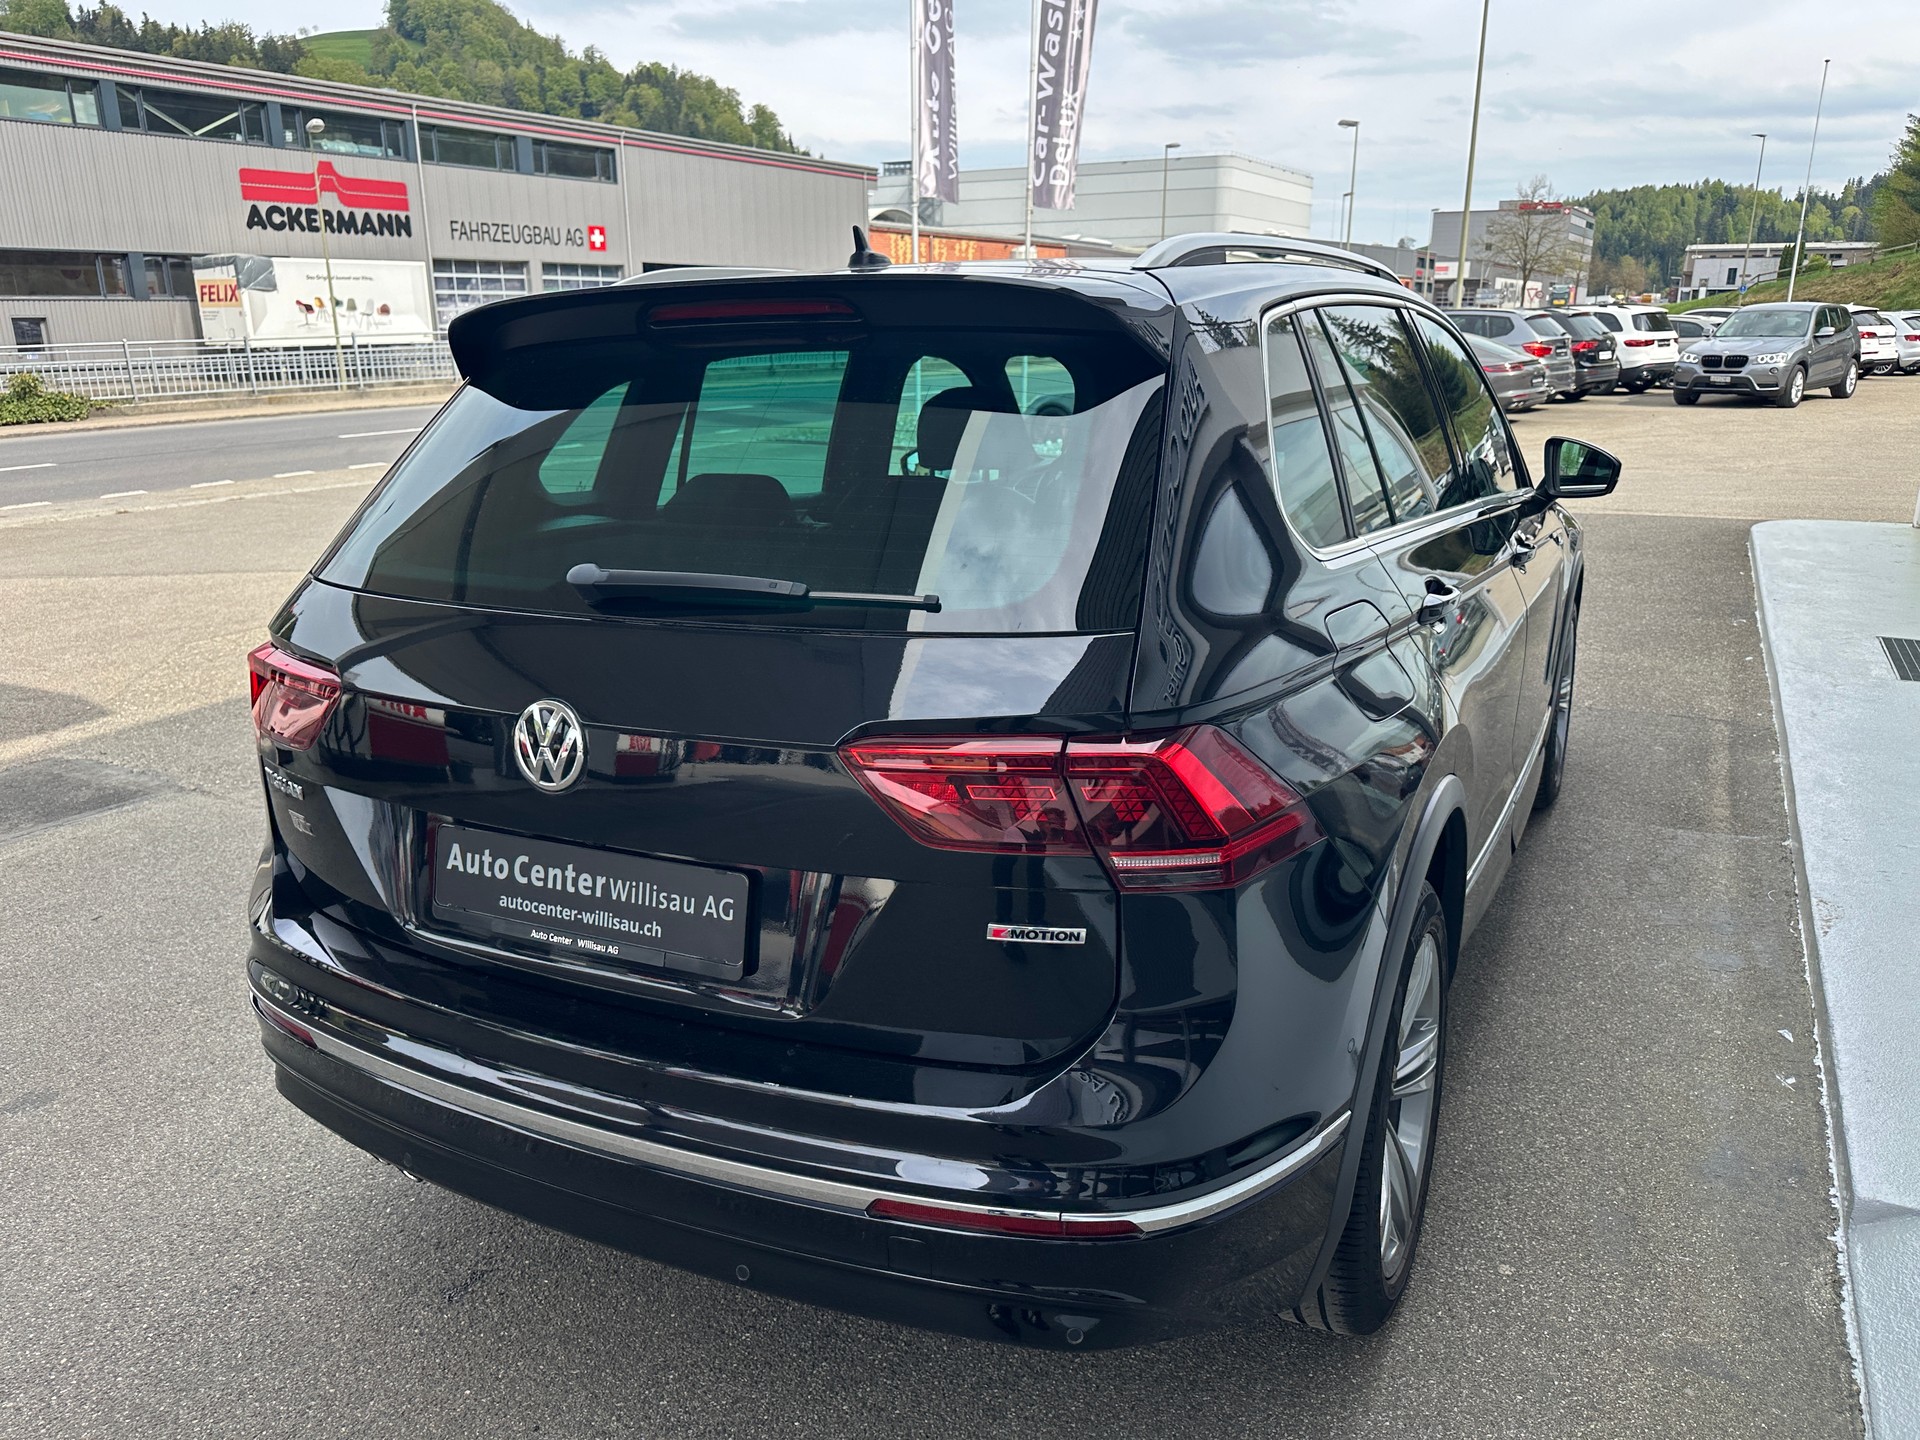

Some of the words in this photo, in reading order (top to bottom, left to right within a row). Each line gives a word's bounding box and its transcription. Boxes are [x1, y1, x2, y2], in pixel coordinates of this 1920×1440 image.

[1032, 0, 1066, 187] Car-Was
[924, 71, 940, 170] Auto
[246, 204, 412, 238] ACKERMANN
[450, 220, 561, 246] FAHRZEUGBAU
[565, 228, 584, 247] AG
[200, 283, 239, 303] FELIX
[447, 843, 509, 880] Auto
[513, 855, 607, 898] Center
[609, 878, 695, 915] Willisau
[702, 895, 734, 922] AG
[499, 893, 662, 939] autocenter-willisau.ch
[530, 929, 548, 942] Auto
[548, 932, 573, 946] Center
[577, 938, 606, 953] Willisau
[606, 944, 619, 955] AG
